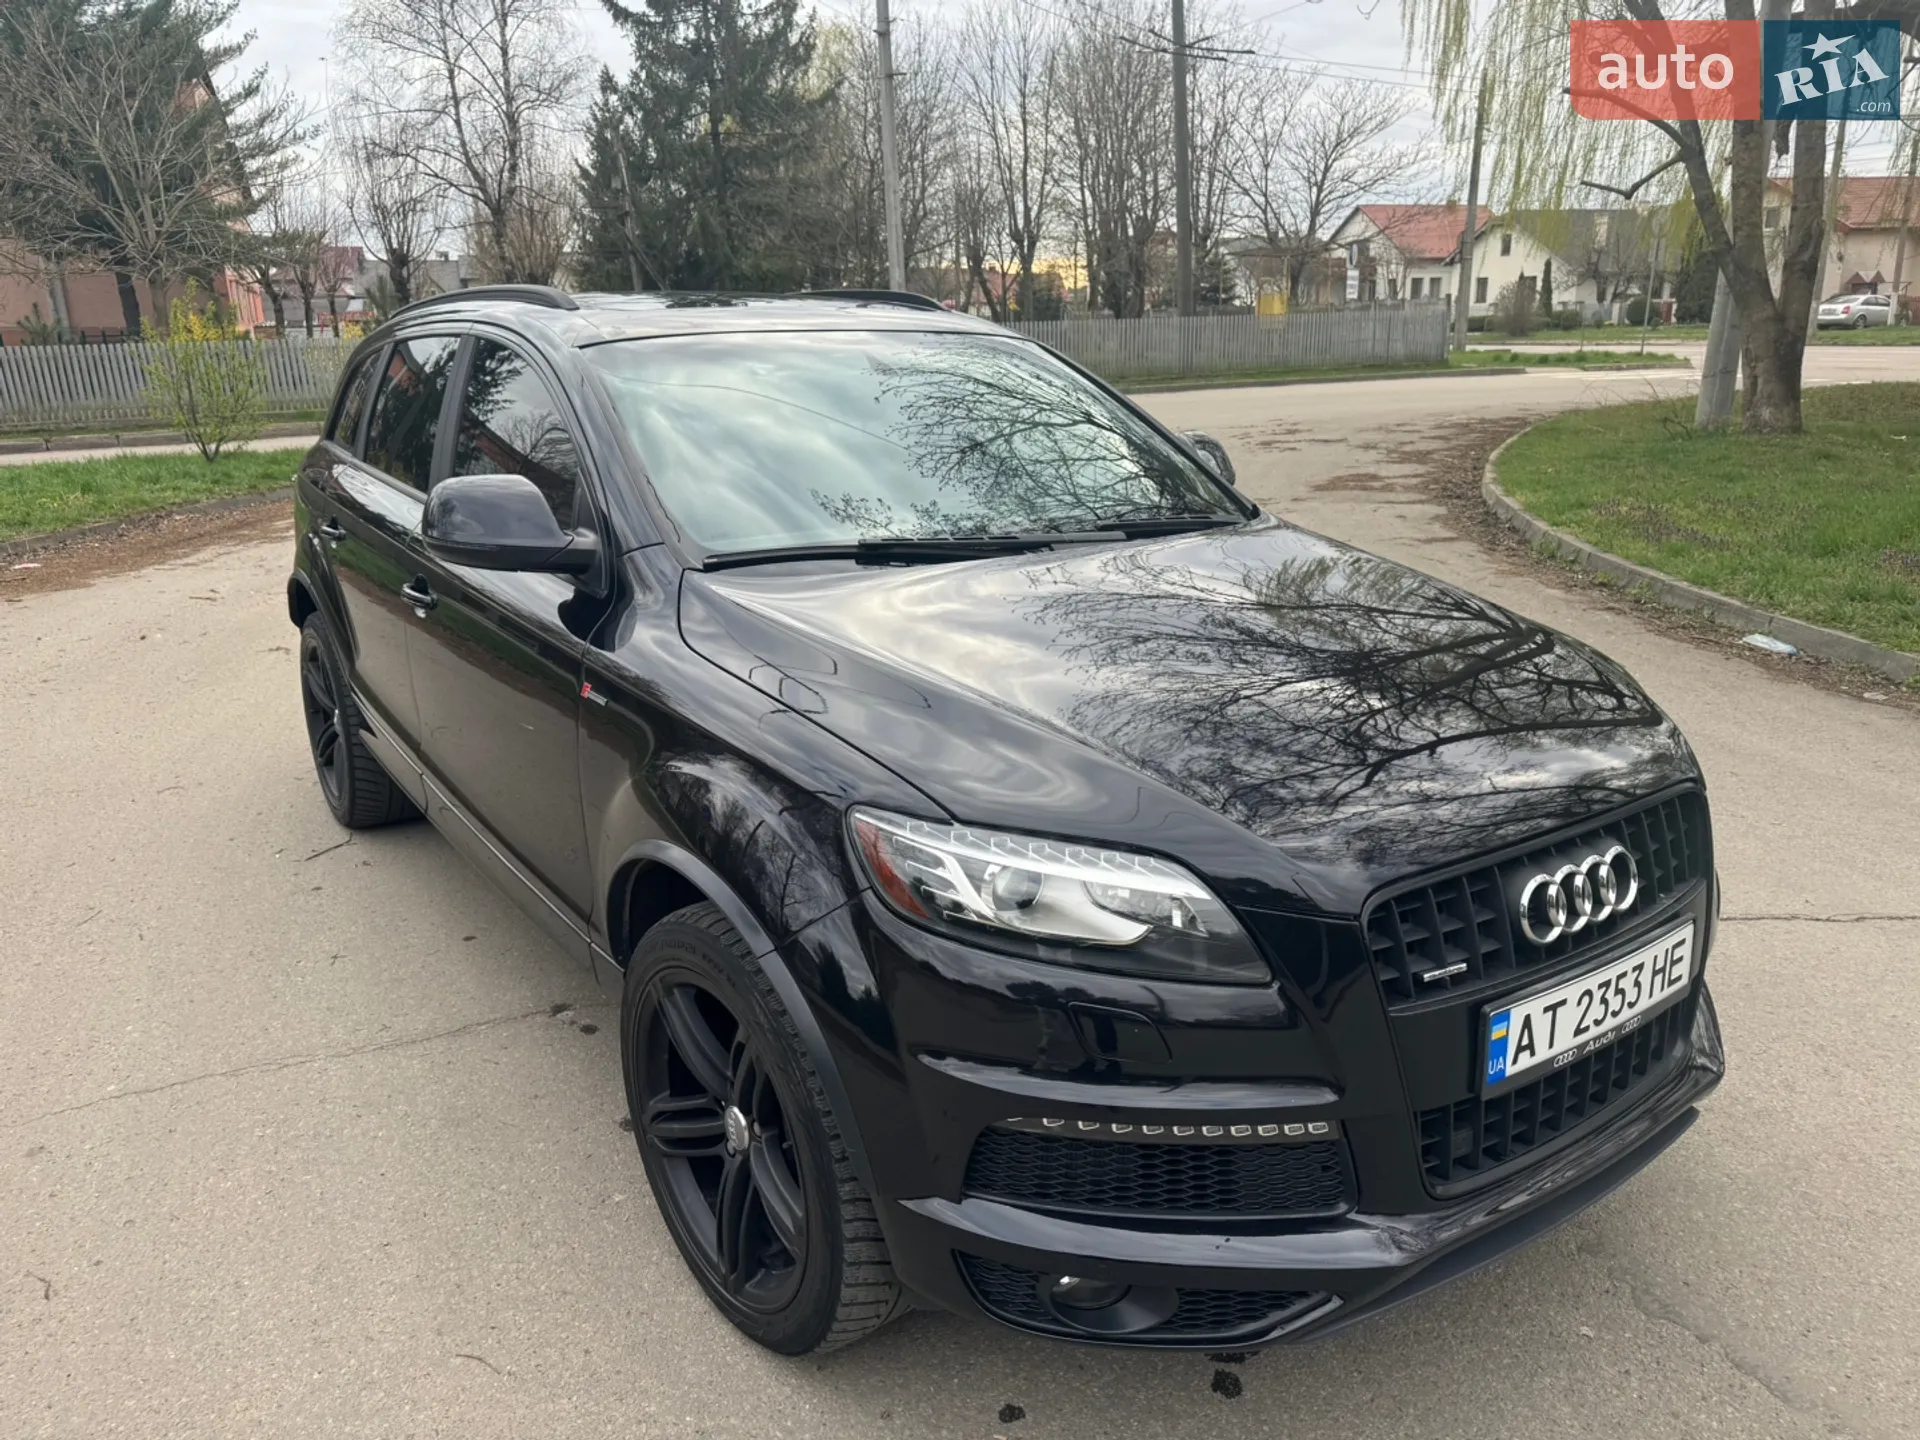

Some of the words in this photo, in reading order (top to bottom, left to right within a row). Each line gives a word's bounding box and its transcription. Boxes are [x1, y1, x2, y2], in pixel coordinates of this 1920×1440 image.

[1511, 998, 1568, 1066] AT
[1573, 961, 1645, 1039] 2353
[1648, 938, 1686, 1000] HE
[1583, 1031, 1616, 1055] Audi
[1488, 1057, 1505, 1075] UA
